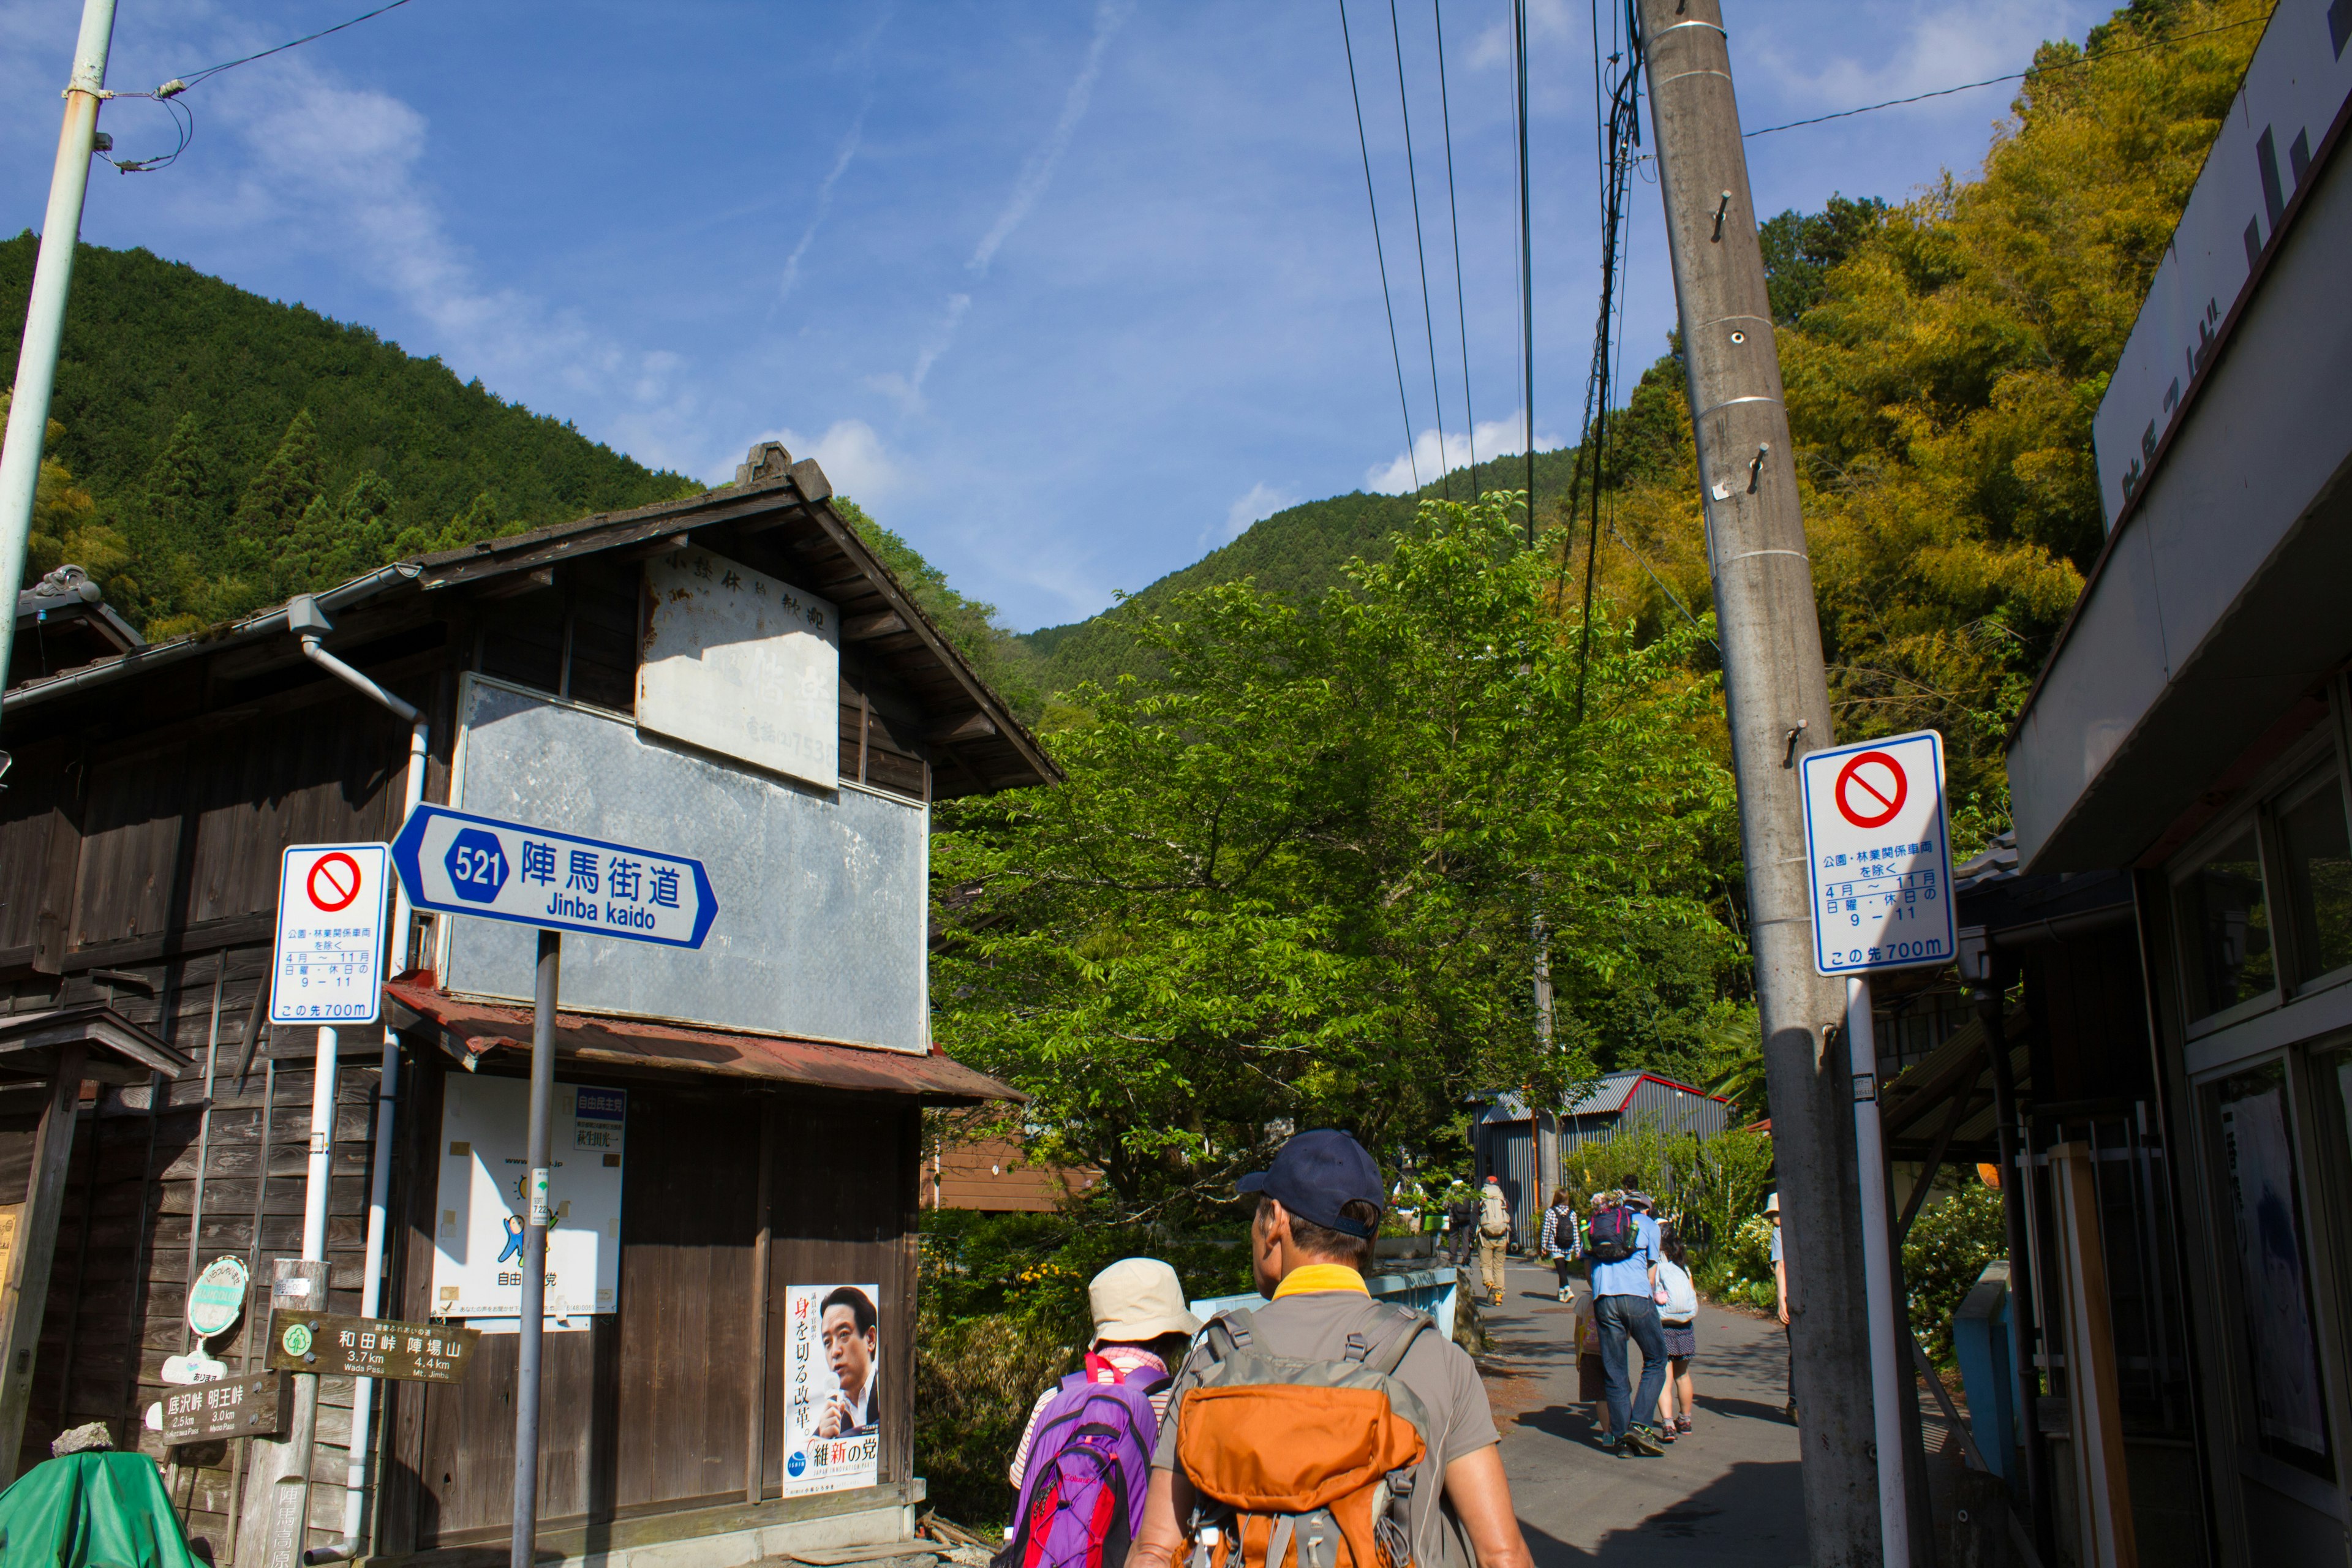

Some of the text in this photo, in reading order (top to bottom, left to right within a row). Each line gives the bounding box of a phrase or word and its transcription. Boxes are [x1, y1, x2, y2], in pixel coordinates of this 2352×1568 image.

[1823, 841, 1932, 868] 公園・林業関係車両
[455, 846, 500, 886] 521
[522, 840, 680, 909] 陣馬街道
[1860, 862, 1896, 877] を除く
[547, 892, 655, 930] Jinba kaido
[288, 928, 371, 939] 公園・林業関係車両
[315, 941, 342, 950] を除く
[578, 1095, 623, 1112] 自由民主党
[498, 1272, 557, 1286] 自由党
[195, 1287, 243, 1302] FUJICOLOR
[339, 1330, 461, 1358] 和田峠 陣場山
[344, 1363, 449, 1379] Wada Pass Mt. Jimba
[793, 1296, 811, 1437] 身を切る改革。
[167, 1384, 244, 1415] 底沢峠 明王峠
[223, 1422, 235, 1431] Pass
[814, 1437, 876, 1467] 維新の党
[813, 1468, 828, 1476] JAPAN
[830, 1464, 860, 1474] INNOVATION
[270, 1486, 298, 1568] 陣馬高原
